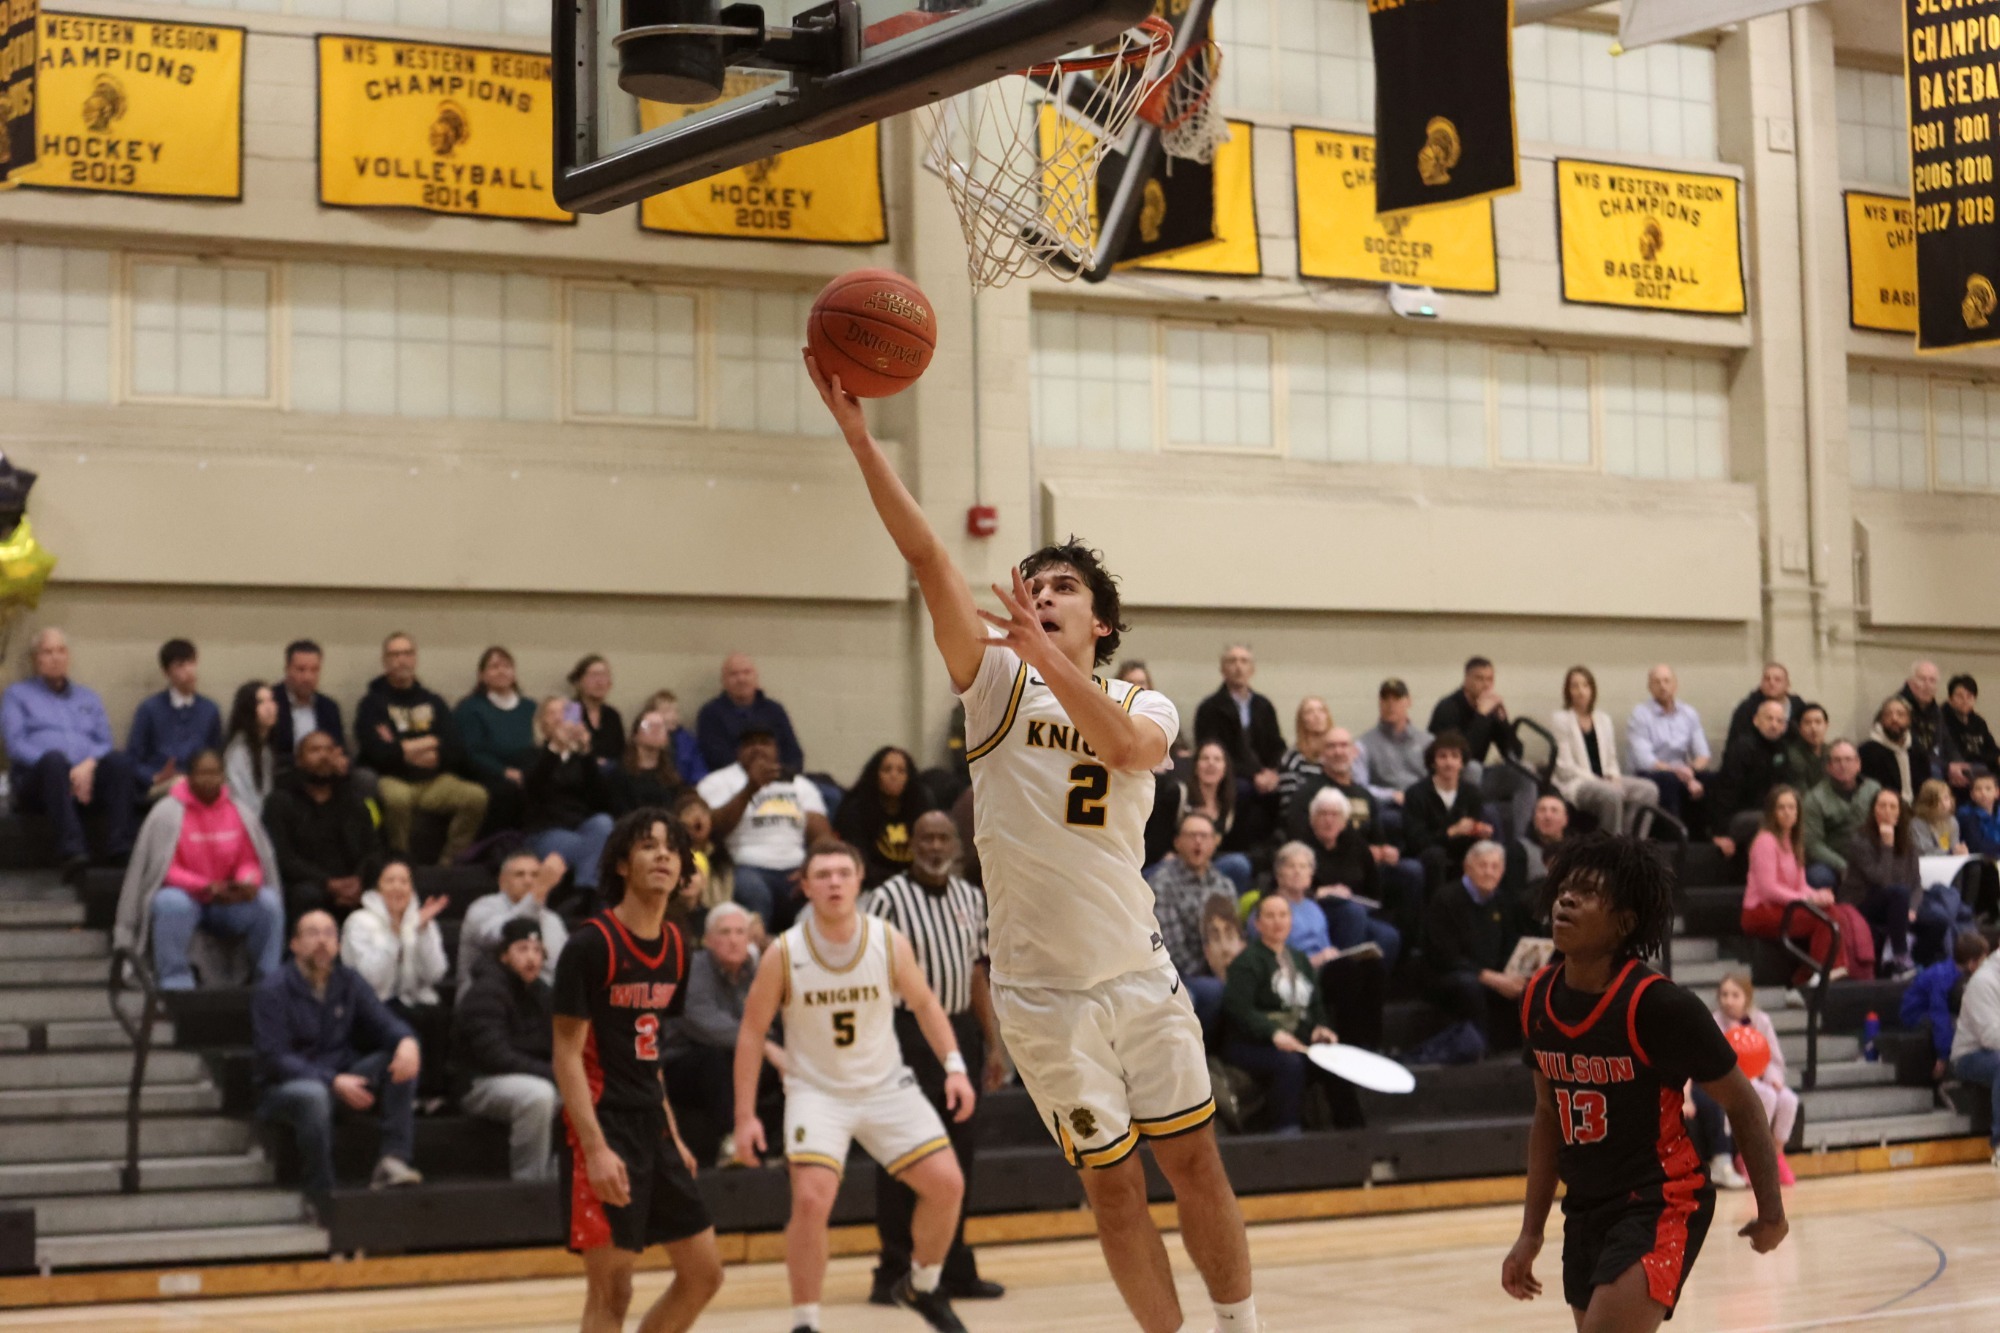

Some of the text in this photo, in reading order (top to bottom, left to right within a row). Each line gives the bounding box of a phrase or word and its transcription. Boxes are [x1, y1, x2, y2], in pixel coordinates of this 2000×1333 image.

[46, 19, 135, 45] WESTERN
[151, 26, 219, 51] REGION
[343, 43, 551, 82] NYS WESTERN REGION
[365, 75, 533, 113] CHAMPIONS
[1919, 62, 2000, 111] BASEBA
[1954, 113, 1990, 144] 2001
[43, 135, 163, 163] HOCKEY
[1315, 141, 1343, 160] NYS
[70, 161, 136, 185] 2013
[353, 157, 544, 190] VOLLEYBALL
[1574, 172, 1723, 201] NYS WESTERN REGION
[1915, 154, 1993, 193] 2006 2010
[422, 183, 480, 208] 2014
[710, 184, 813, 209] HOCKEY
[736, 208, 791, 229] 2015
[1599, 197, 1701, 228] CHAMPIONS
[1864, 204, 1887, 222] NYS
[1917, 195, 1994, 234] 2017 2019
[1364, 236, 1433, 258] SOCCER
[1380, 257, 1419, 277] 2017
[1604, 260, 1699, 285] BASEBALL
[1634, 282, 1672, 300] 2017
[844, 321, 926, 368] SPALDING
[1065, 763, 1111, 829] 2
[804, 986, 880, 1006] KNIGHTS
[635, 1012, 660, 1061] 2
[832, 1011, 856, 1048] 5
[1555, 1088, 1607, 1145] 13
